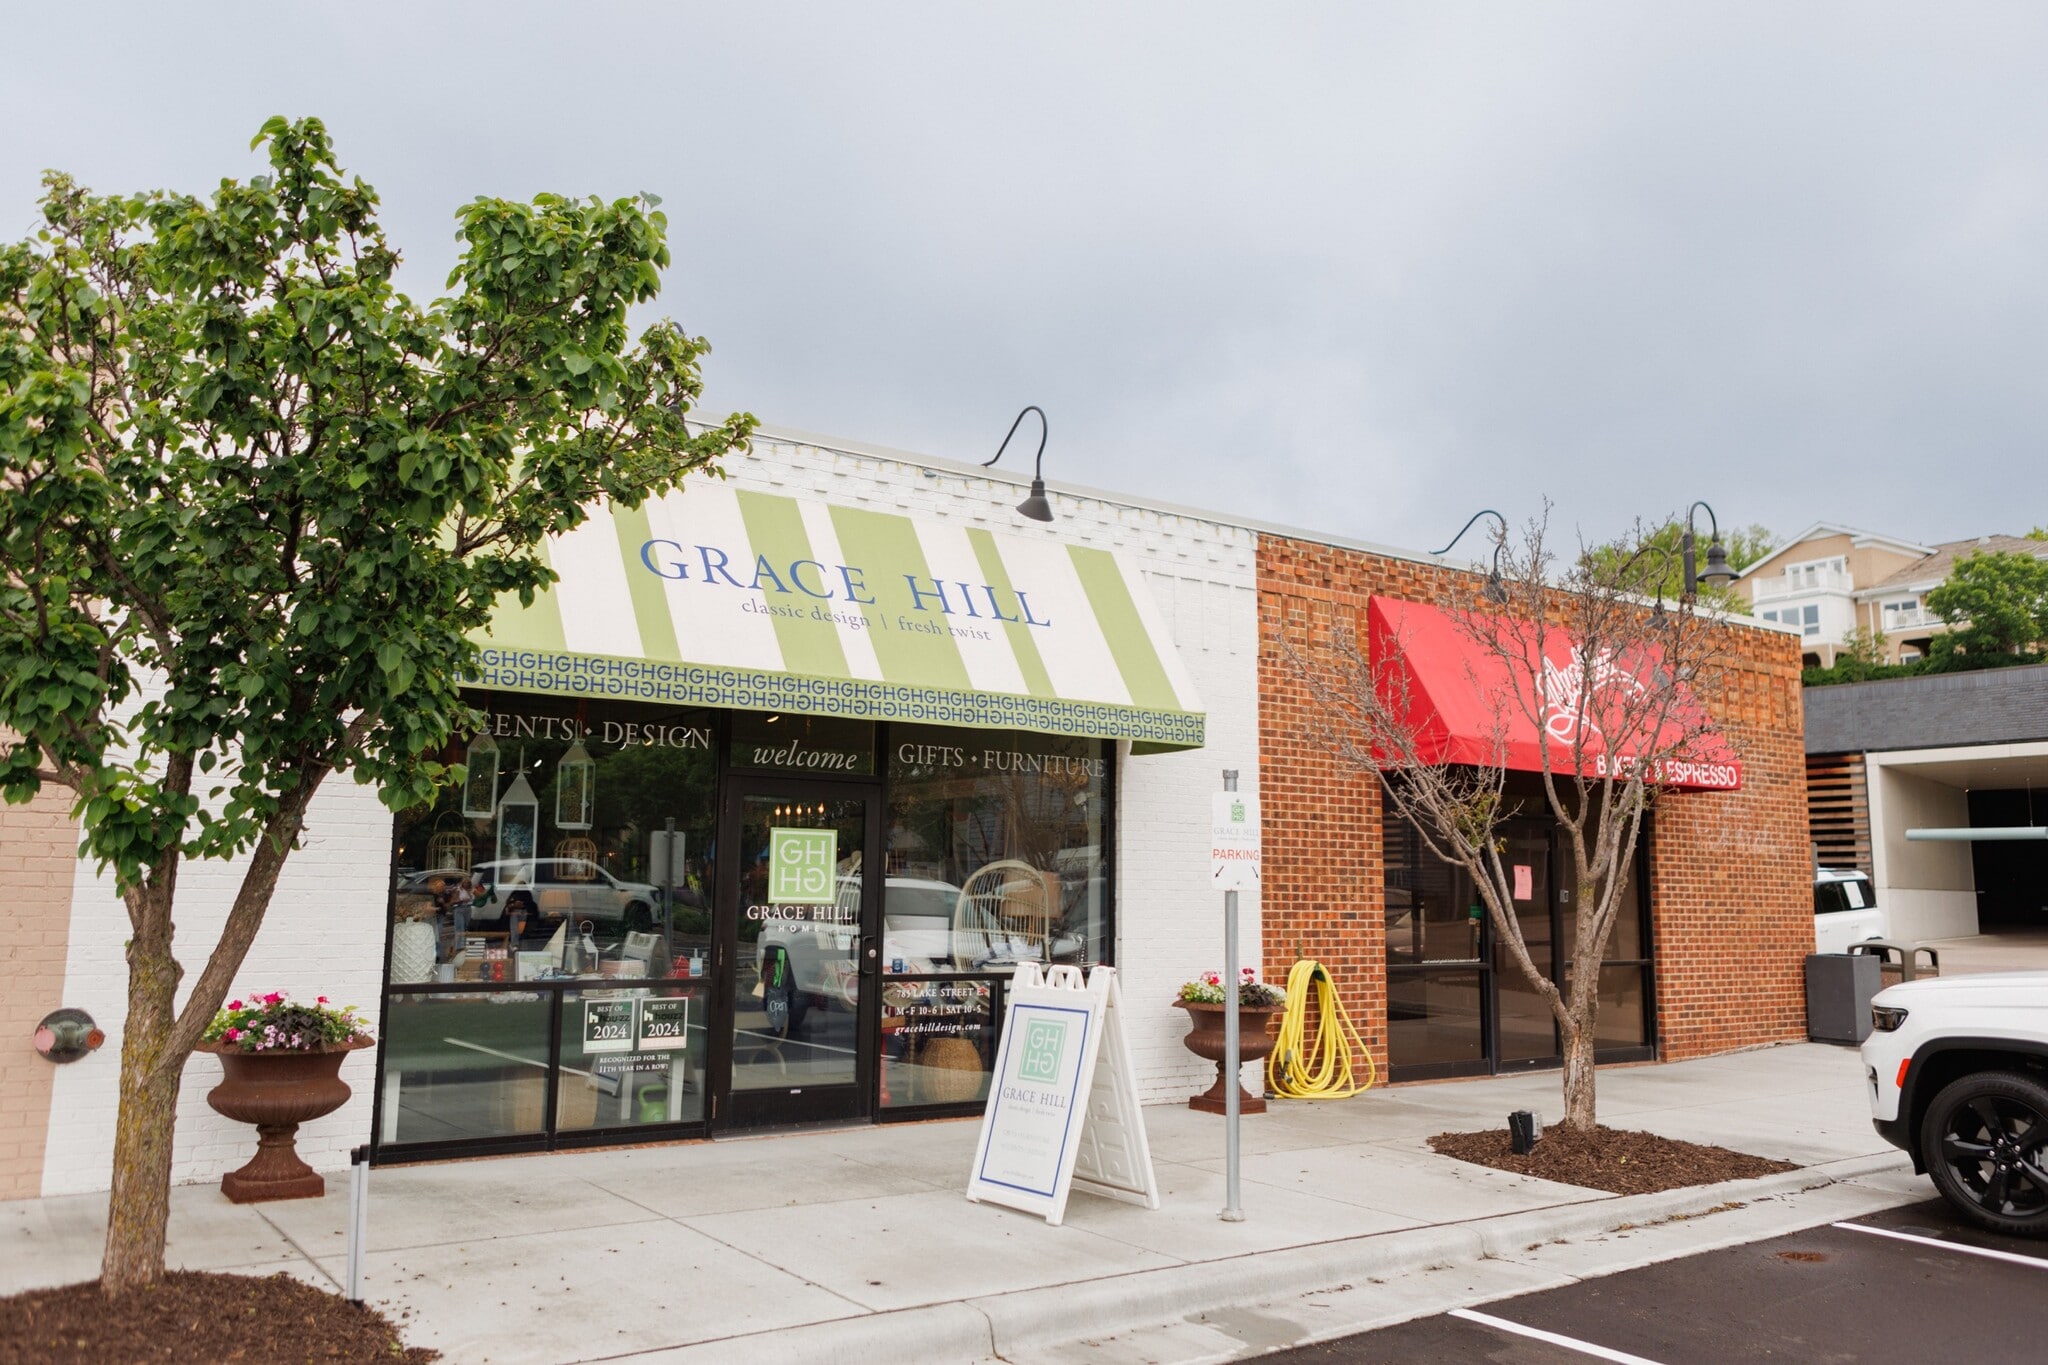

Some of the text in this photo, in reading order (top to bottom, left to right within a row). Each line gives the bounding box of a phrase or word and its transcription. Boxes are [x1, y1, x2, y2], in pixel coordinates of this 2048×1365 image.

[640, 539, 1051, 627] GRACE HILL
[742, 598, 805, 619] classic
[811, 606, 871, 631] design
[898, 616, 943, 636] fresh
[948, 626, 992, 641] twist
[602, 721, 712, 750] DESIGN
[753, 740, 858, 770] welcome
[898, 743, 1105, 778] GIFTS FURNITURE
[1666, 761, 1738, 787] ESPRESSO
[780, 839, 826, 865] GH
[1212, 848, 1260, 861] PARKING
[747, 906, 853, 920] GRACE HILL
[778, 925, 820, 933] HOME
[913, 989, 938, 997] LAKE
[940, 987, 974, 997] STREET
[770, 1000, 788, 1016] Open
[946, 1005, 962, 1015] SAT
[593, 1024, 627, 1039] 2024
[647, 1021, 680, 1037] 2024
[894, 1022, 981, 1036] gracehilldesign.com
[600, 1055, 641, 1063] RECOGNIZED
[1003, 1086, 1067, 1109] GRACE HILL
